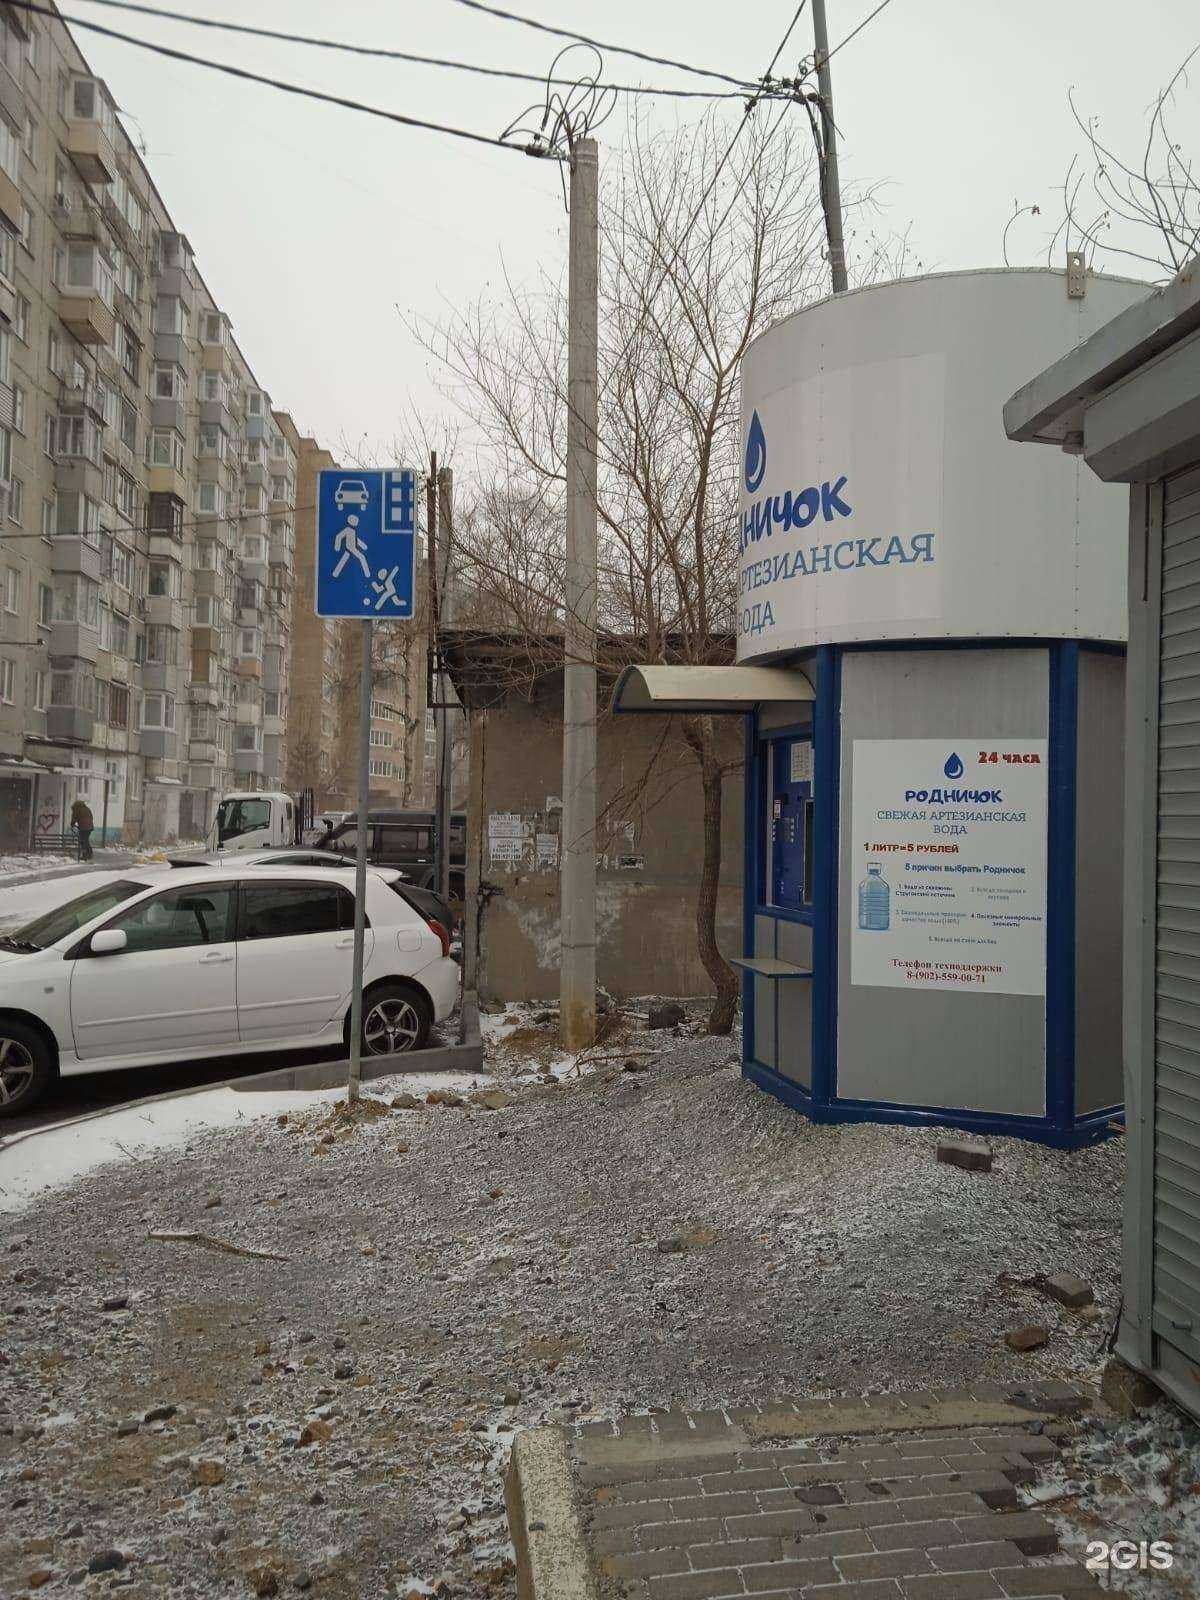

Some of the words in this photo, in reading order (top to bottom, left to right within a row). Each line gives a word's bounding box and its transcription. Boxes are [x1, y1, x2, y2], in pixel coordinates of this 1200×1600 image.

[978, 751, 998, 764] 24
[905, 789, 1002, 804] РОДНИЧОК
[877, 811, 926, 820] СВЕЖАЯ
[930, 811, 1026, 822] АРТЕЗИАНСКАЯ
[933, 825, 967, 835] ВОДА
[863, 842, 869, 851] 1
[916, 843, 959, 853] РУБЛЕЙ
[905, 863, 910, 871] 5
[912, 864, 942, 872] причин
[944, 864, 981, 874] выбрать
[983, 865, 1025, 874] Родничок
[892, 959, 931, 969] Телефон
[934, 962, 1002, 973] техподдержки
